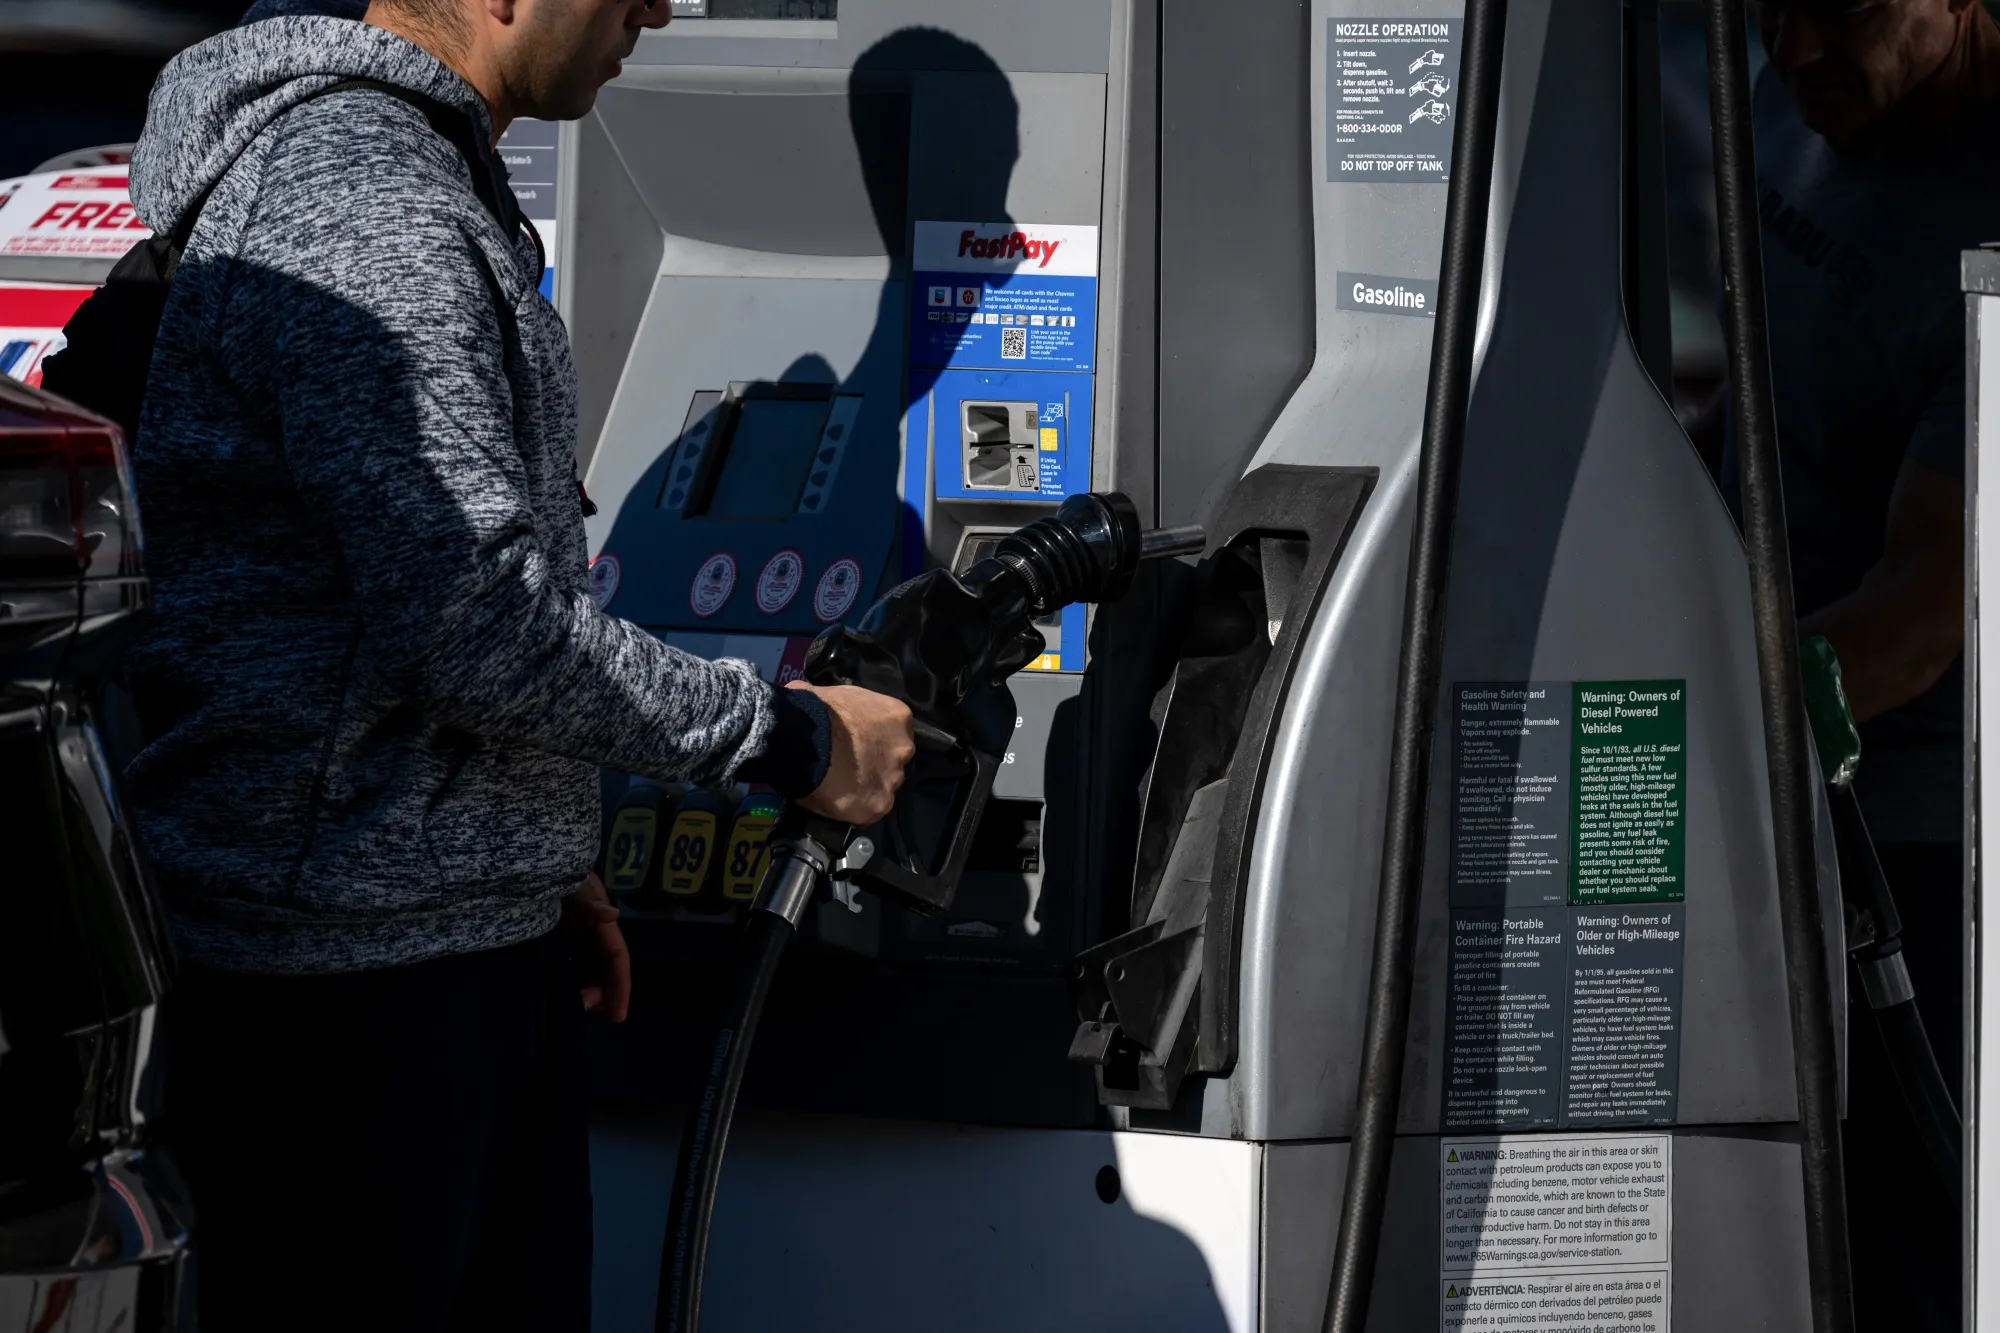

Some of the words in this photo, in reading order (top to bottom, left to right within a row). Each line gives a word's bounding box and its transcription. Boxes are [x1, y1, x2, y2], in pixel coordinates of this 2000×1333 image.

[1337, 24, 1379, 35] NOZZLE
[1382, 24, 1448, 35] OPERATION
[1337, 124, 1402, 132] 1-800-334-ODOR
[1341, 161, 1354, 170] DO
[1356, 161, 1374, 170] NOT
[1376, 161, 1395, 170] TOP
[1396, 161, 1415, 170] OFF
[1417, 161, 1443, 170] TANK
[958, 230, 1060, 268] FastPay
[1353, 282, 1425, 309] Gasoline
[1461, 691, 1499, 699] Gasoline
[1500, 690, 1528, 700] Safety
[1529, 690, 1545, 698] and
[1581, 691, 1626, 705] Warning:
[1629, 690, 1668, 701] Owners
[1670, 690, 1680, 700] of
[1462, 702, 1489, 711] Health
[1491, 701, 1527, 712] Warning
[1581, 707, 1611, 718] Diesel
[1615, 706, 1658, 717] Powered
[1461, 719, 1487, 728] Danger,
[1489, 719, 1522, 728] extremely
[1524, 718, 1560, 726] flammable
[1581, 722, 1622, 733] Vehicles
[1581, 746, 1600, 754] Since
[1602, 745, 1631, 755] 10/1/93,
[1633, 745, 1642, 753] all
[1643, 745, 1658, 753] U.S.
[1660, 744, 1680, 752] diesel
[613, 833, 645, 870] 91
[670, 835, 706, 873] 89
[731, 840, 768, 877] 87
[1456, 920, 1500, 932] Warning:
[1503, 919, 1544, 929] Portable
[1577, 916, 1619, 928] Warning:
[1622, 915, 1659, 925] Owners
[1661, 914, 1671, 924] of
[1455, 935, 1503, 946] Container
[1506, 935, 1524, 945] Fire
[1527, 934, 1561, 944] Hazard
[1577, 930, 1603, 940] Older
[1605, 932, 1616, 940] or
[1618, 929, 1680, 942] High-Mileage
[1576, 944, 1615, 955] Vehicles
[1460, 1150, 1507, 1161] WARNING:
[1510, 1149, 1551, 1161] Breathing
[1553, 1148, 1567, 1158] the
[1569, 1148, 1580, 1157] air
[1582, 1148, 1590, 1157] in
[1591, 1147, 1608, 1156] this
[1609, 1148, 1628, 1156] area
[1641, 1145, 1658, 1155] skin
[1446, 1166, 1477, 1176] contact
[1479, 1165, 1498, 1175] with
[1500, 1163, 1544, 1177] petroleum
[1546, 1162, 1584, 1175] products
[1586, 1163, 1601, 1171] can
[1603, 1162, 1633, 1173] expose
[1635, 1162, 1651, 1172] you
[1653, 1159, 1662, 1168] to
[1446, 1180, 1489, 1190] chemicals
[1489, 1178, 1530, 1191] including
[1532, 1177, 1570, 1190] benzene,
[1572, 1176, 1598, 1186] motor
[1600, 1175, 1630, 1185] vehicle
[1631, 1173, 1665, 1183] exhaust
[1446, 1195, 1462, 1204] and
[1464, 1194, 1494, 1204] carbon
[1497, 1192, 1542, 1204] monoxide,
[1544, 1191, 1569, 1201] which
[1587, 1190, 1615, 1199] known
[1617, 1189, 1626, 1198] to
[1628, 1189, 1642, 1198] the
[1644, 1188, 1666, 1197] State
[1446, 1210, 1455, 1219] of
[1457, 1208, 1498, 1218] California
[1500, 1208, 1509, 1217] to
[1537, 1207, 1566, 1215] cancer
[1568, 1205, 1584, 1214] and
[1586, 1204, 1605, 1214] birth
[1607, 1203, 1638, 1213] defects
[1446, 1224, 1469, 1233] other
[1471, 1222, 1525, 1235] reproductive
[1527, 1221, 1552, 1230] harm.
[1554, 1220, 1567, 1229] Do
[1569, 1219, 1583, 1229] not
[1585, 1219, 1602, 1231] stay
[1605, 1218, 1612, 1227] in
[1614, 1218, 1630, 1227] this
[1446, 1238, 1474, 1250] longer
[1475, 1237, 1495, 1246] than
[1497, 1237, 1541, 1248] necessary.
[1544, 1234, 1558, 1244] For
[1560, 1235, 1582, 1243] more
[1584, 1231, 1634, 1242] information
[1636, 1233, 1647, 1243] go
[1649, 1230, 1658, 1240] to
[1446, 1247, 1622, 1264] www.P65Warnings.ca.gov/service-station.
[1460, 1284, 1526, 1295] ADVERTENCIA:
[1528, 1282, 1563, 1295] Respirar
[1565, 1282, 1573, 1291] el
[1575, 1281, 1591, 1291] aire
[1606, 1280, 1623, 1290] esta
[1625, 1280, 1644, 1289] área
[1653, 1279, 1661, 1288] el
[1445, 1301, 1482, 1311] contacto
[1484, 1299, 1519, 1310] dérmico
[1539, 1297, 1581, 1308] derivados
[1583, 1296, 1596, 1306] del
[1598, 1295, 1634, 1307] petróleo
[1636, 1294, 1662, 1306] puede
